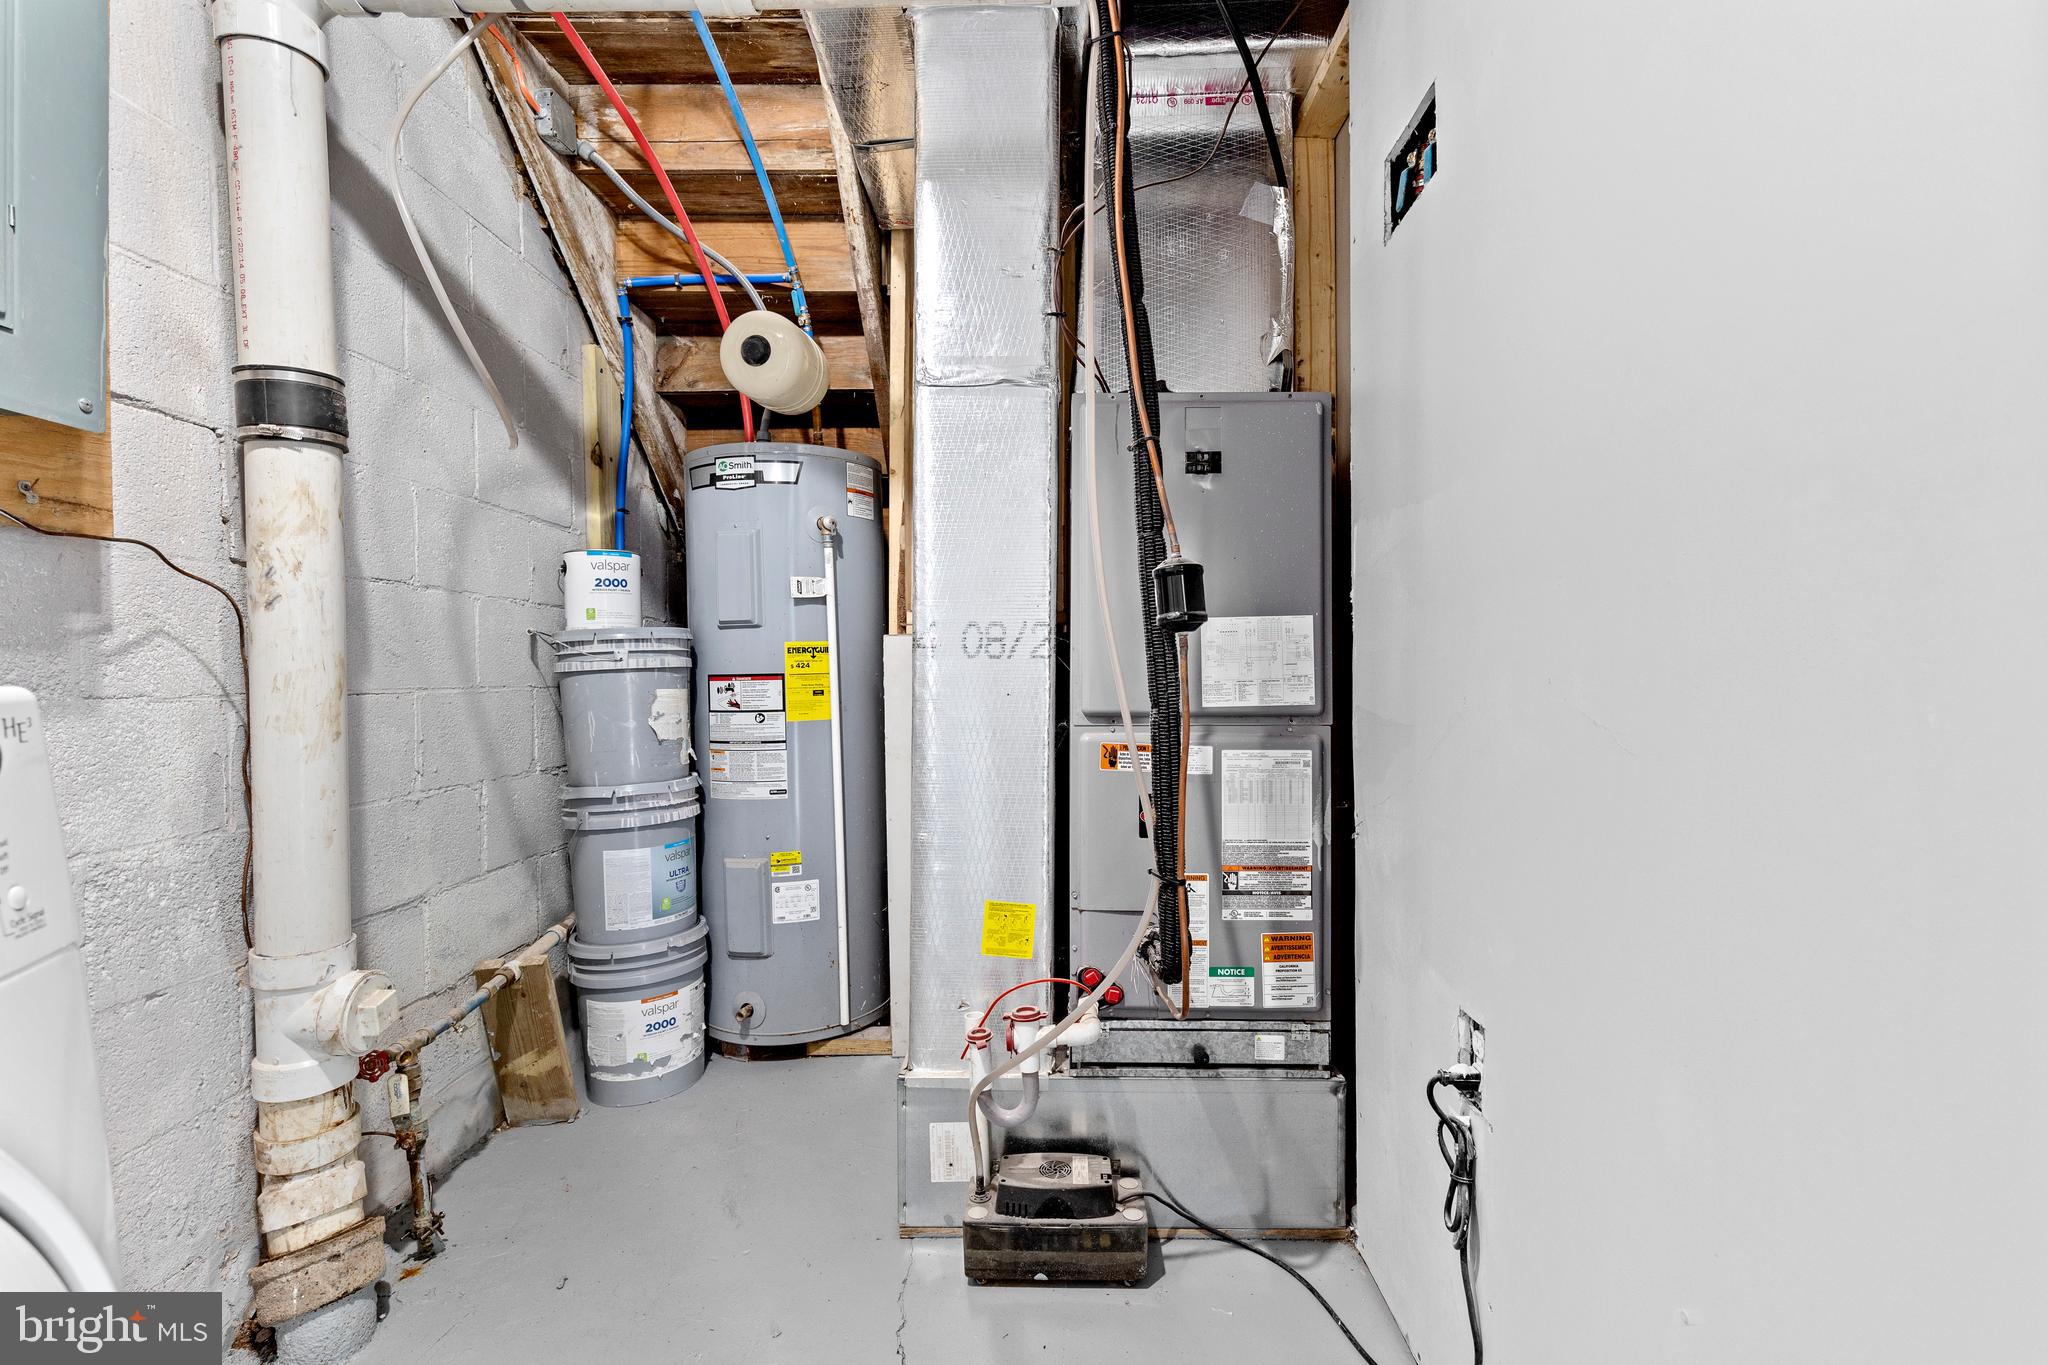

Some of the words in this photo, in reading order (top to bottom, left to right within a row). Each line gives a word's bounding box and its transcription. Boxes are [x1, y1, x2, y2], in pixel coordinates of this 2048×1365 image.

[728, 461, 752, 470] Smith
[590, 559, 631, 573] valspar
[594, 578, 628, 588] 2000
[668, 865, 690, 878] ULTRA
[1217, 968, 1246, 976] NOTICE
[641, 999, 680, 1018] valspar
[645, 1016, 677, 1034] 2000
